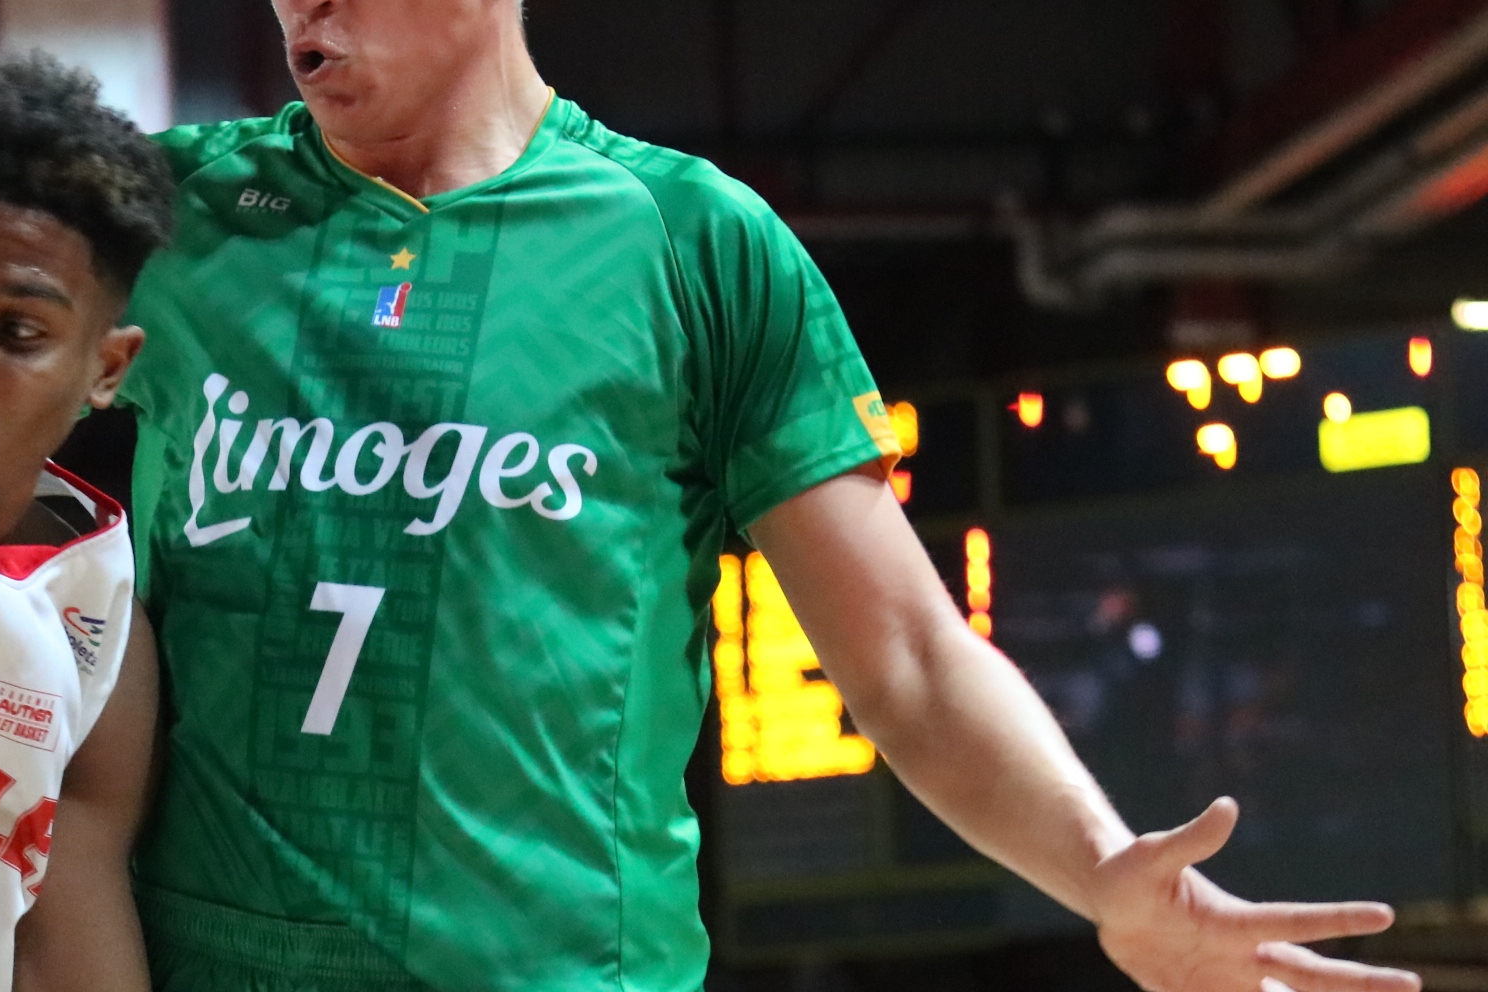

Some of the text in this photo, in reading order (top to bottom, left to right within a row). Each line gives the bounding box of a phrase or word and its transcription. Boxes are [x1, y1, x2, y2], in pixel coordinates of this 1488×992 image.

[373, 314, 400, 328] LNB
[183, 372, 598, 547] Limoges
[300, 581, 386, 736] 7
